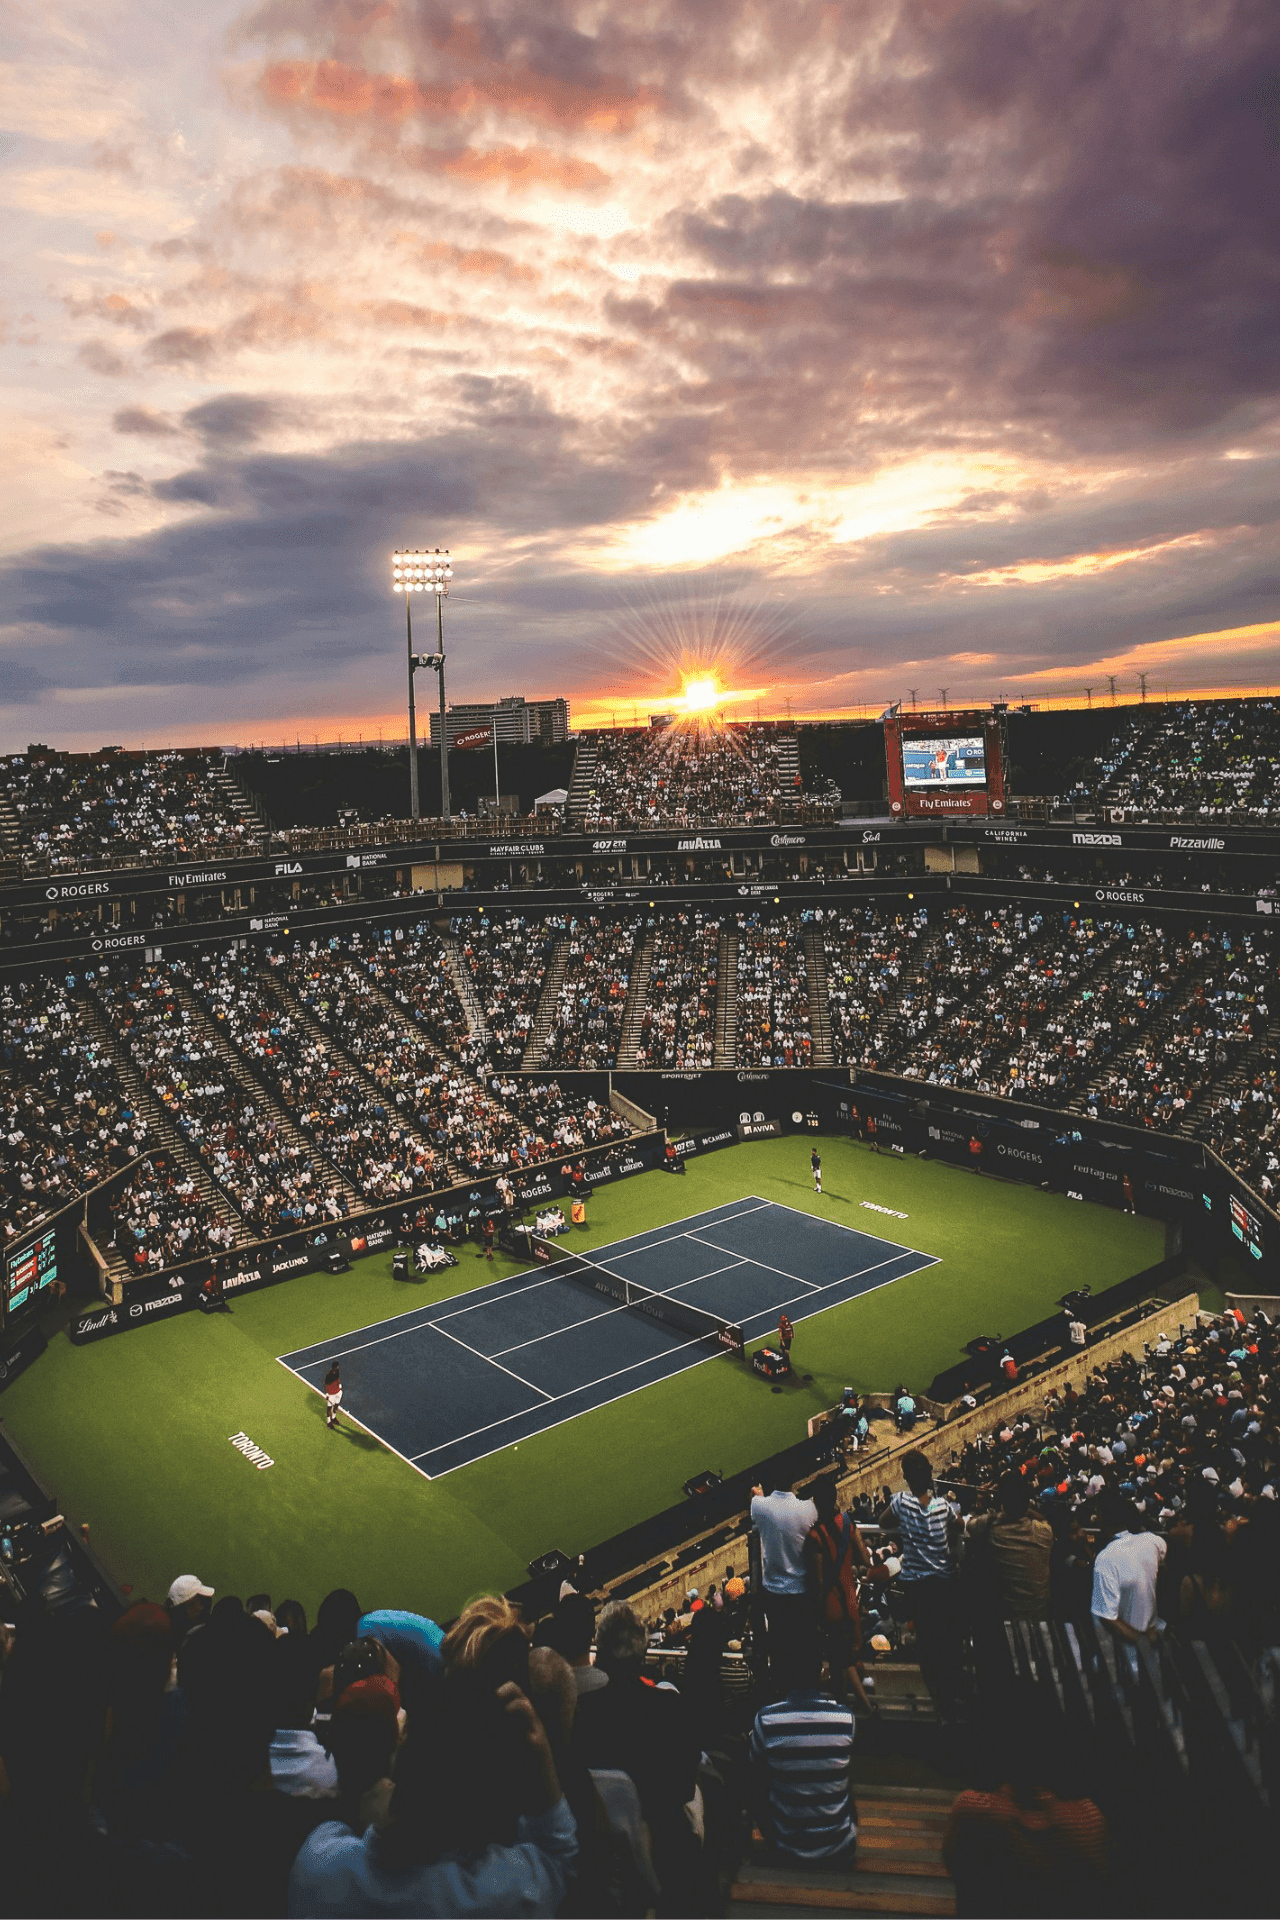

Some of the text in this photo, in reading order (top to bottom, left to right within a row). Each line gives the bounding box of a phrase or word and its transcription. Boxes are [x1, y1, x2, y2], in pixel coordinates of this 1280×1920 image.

[920, 798, 971, 809] Fly Emirates
[985, 830, 1028, 838] CALIFORNIA
[490, 844, 545, 853] MAYFAIR CLUBS
[593, 840, 612, 849] 407
[677, 837, 722, 850] LAVAZZA
[1170, 836, 1225, 849] Pizzaville
[362, 853, 388, 861] NATIONAL
[275, 862, 303, 875] FILA
[168, 872, 227, 887] Fly Emirates
[61, 882, 110, 897] ROGERS
[1107, 891, 1145, 903] ROGERS
[104, 935, 146, 948] ROGERS
[753, 1124, 775, 1133] AVIVA
[891, 1144, 904, 1153] FILA
[1007, 1147, 1043, 1164] ROGERS
[521, 1183, 552, 1199] ROGERS
[1066, 1190, 1083, 1200] FILA
[859, 1200, 910, 1219] TORONTO
[366, 1228, 393, 1241] NATIONAL
[367, 1238, 384, 1247] BANK
[272, 1263, 289, 1274] JACK
[222, 1270, 262, 1290] LAVAZZA
[594, 1282, 610, 1293] ATP
[642, 1303, 665, 1319] TOUR
[76, 1314, 109, 1334] Lindt
[753, 1358, 772, 1376] FedEx
[227, 1430, 275, 1470] TORONTO
